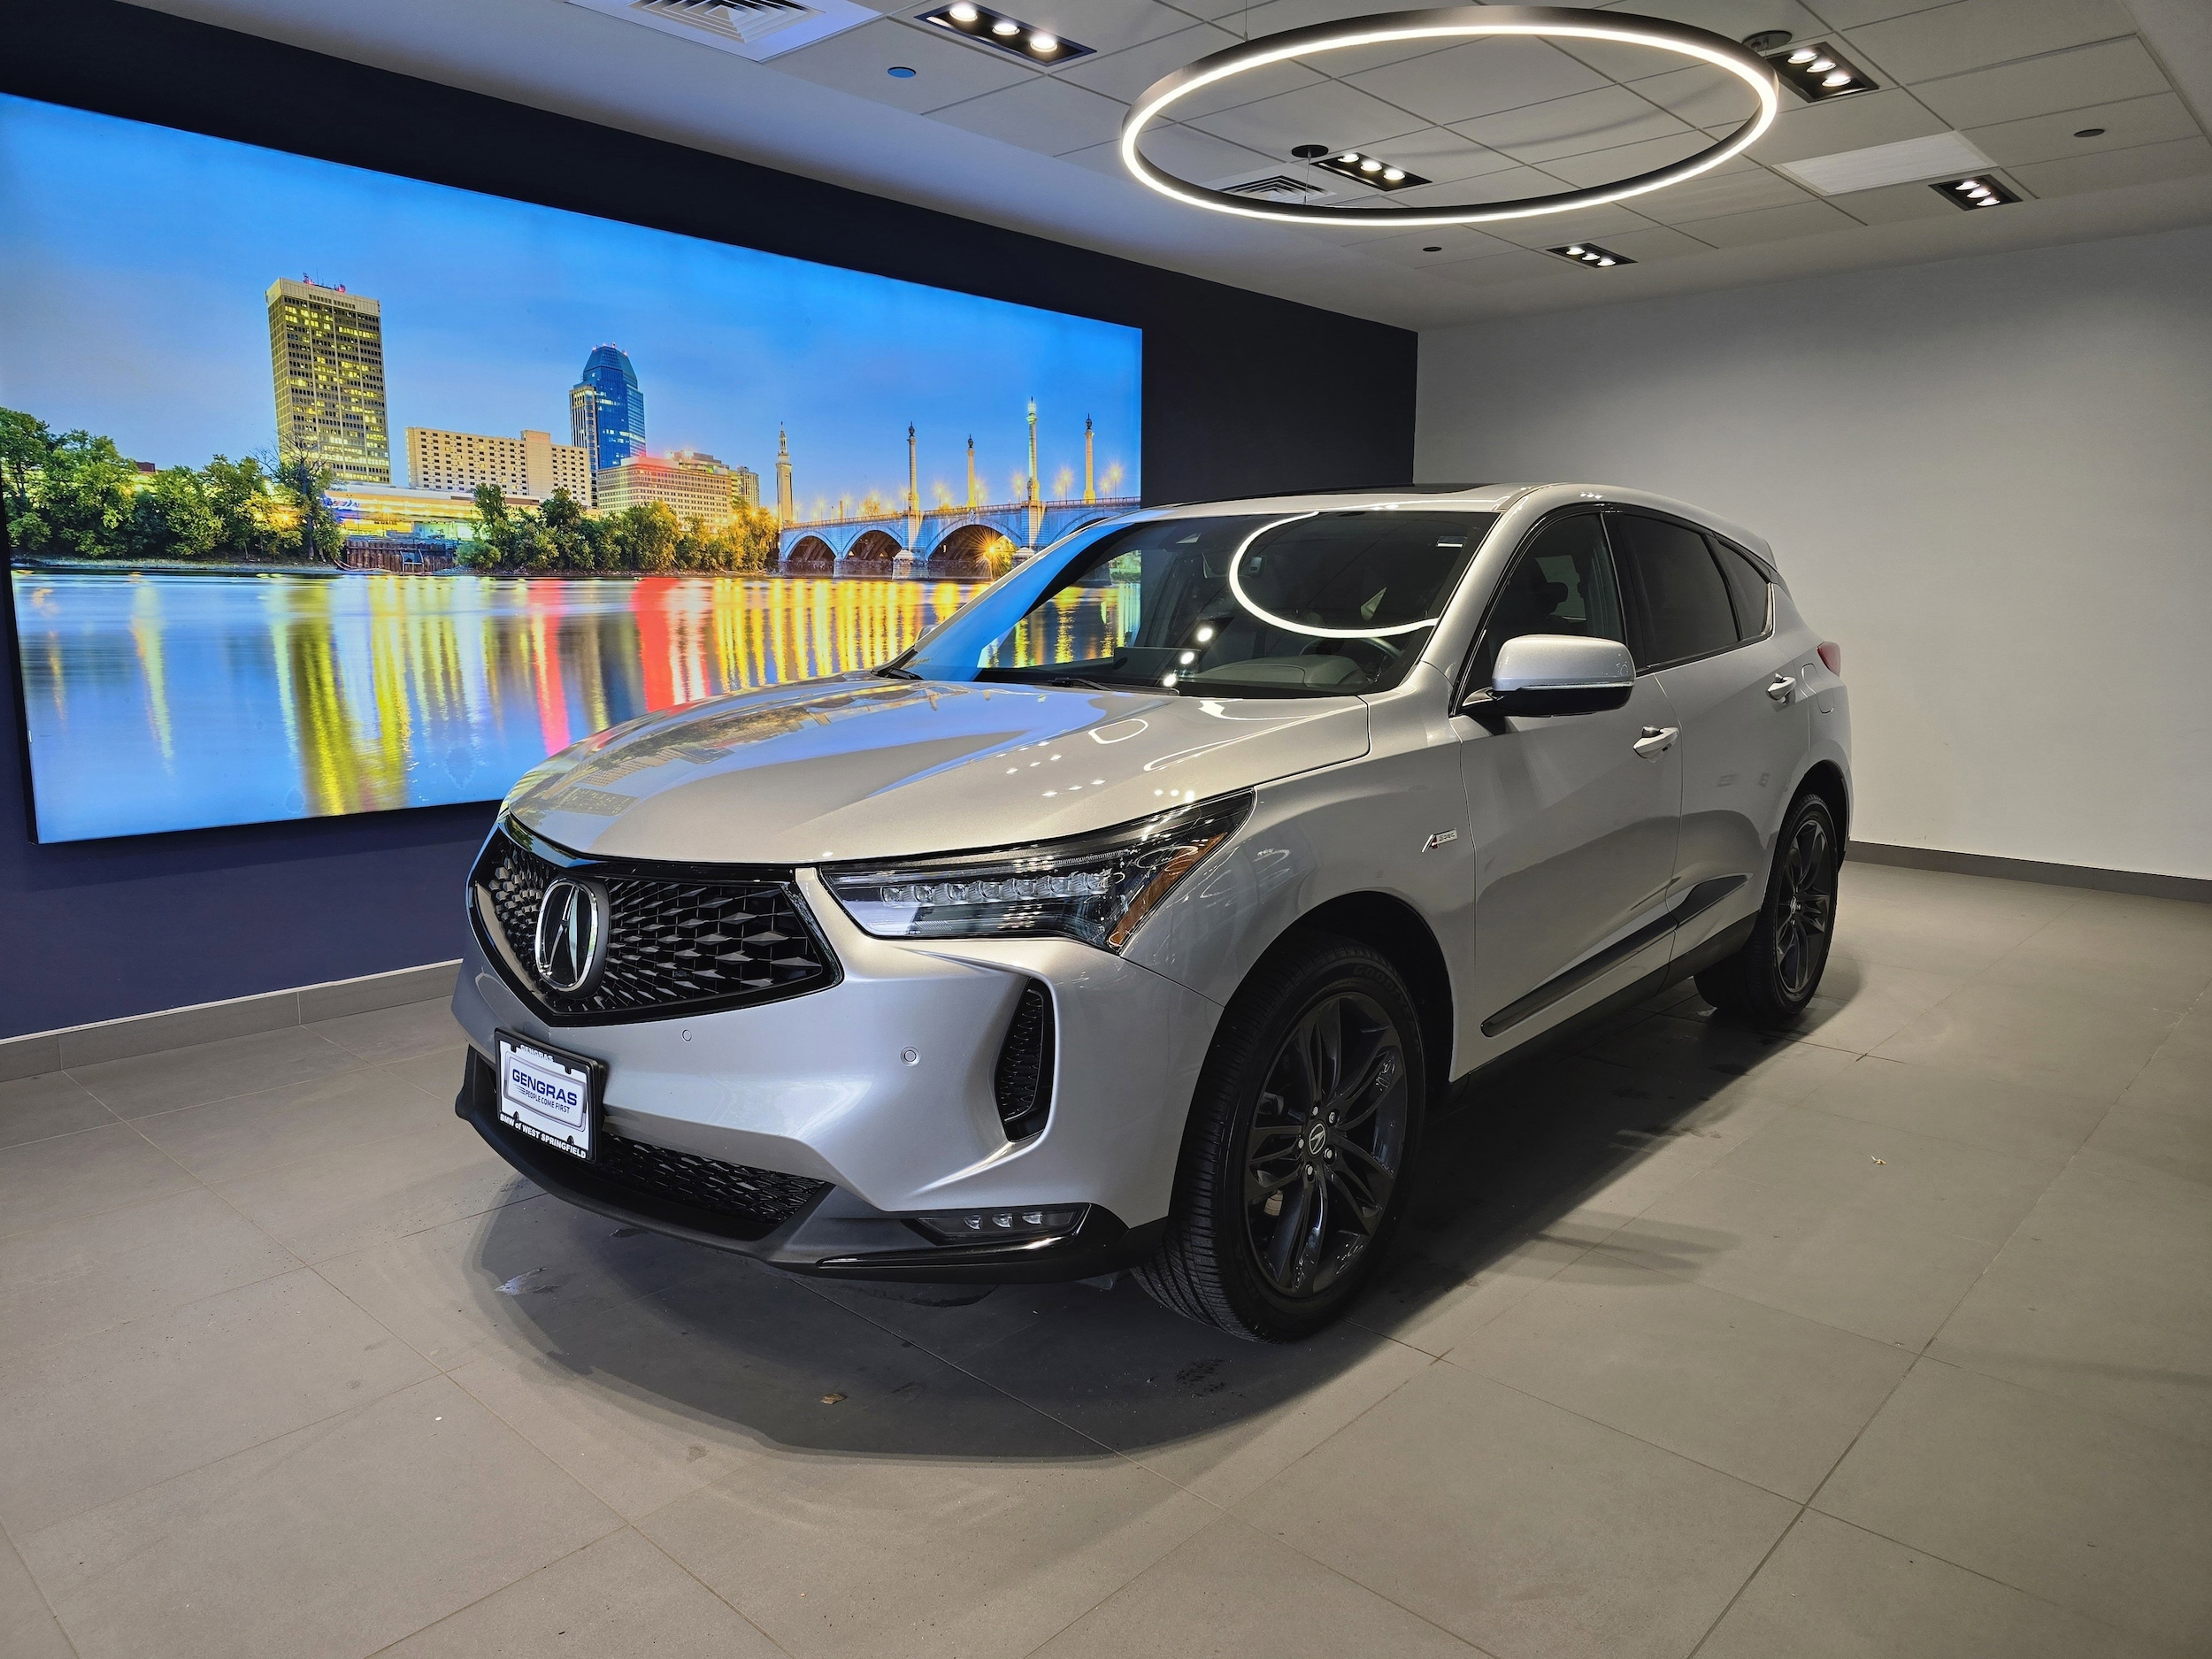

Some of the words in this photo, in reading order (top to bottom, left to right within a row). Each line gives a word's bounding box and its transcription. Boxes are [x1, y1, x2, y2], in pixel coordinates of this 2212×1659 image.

[520, 1044, 554, 1062] GENGRAS
[512, 1068, 578, 1106] GENGRAS
[525, 1089, 541, 1103] PEOPLE
[541, 1096, 555, 1109] COME
[555, 1102, 571, 1114] FIRST
[499, 1113, 515, 1127] BMW
[515, 1122, 522, 1131] of
[522, 1125, 541, 1140] WEST
[541, 1133, 587, 1159] SPRINGFIELD
